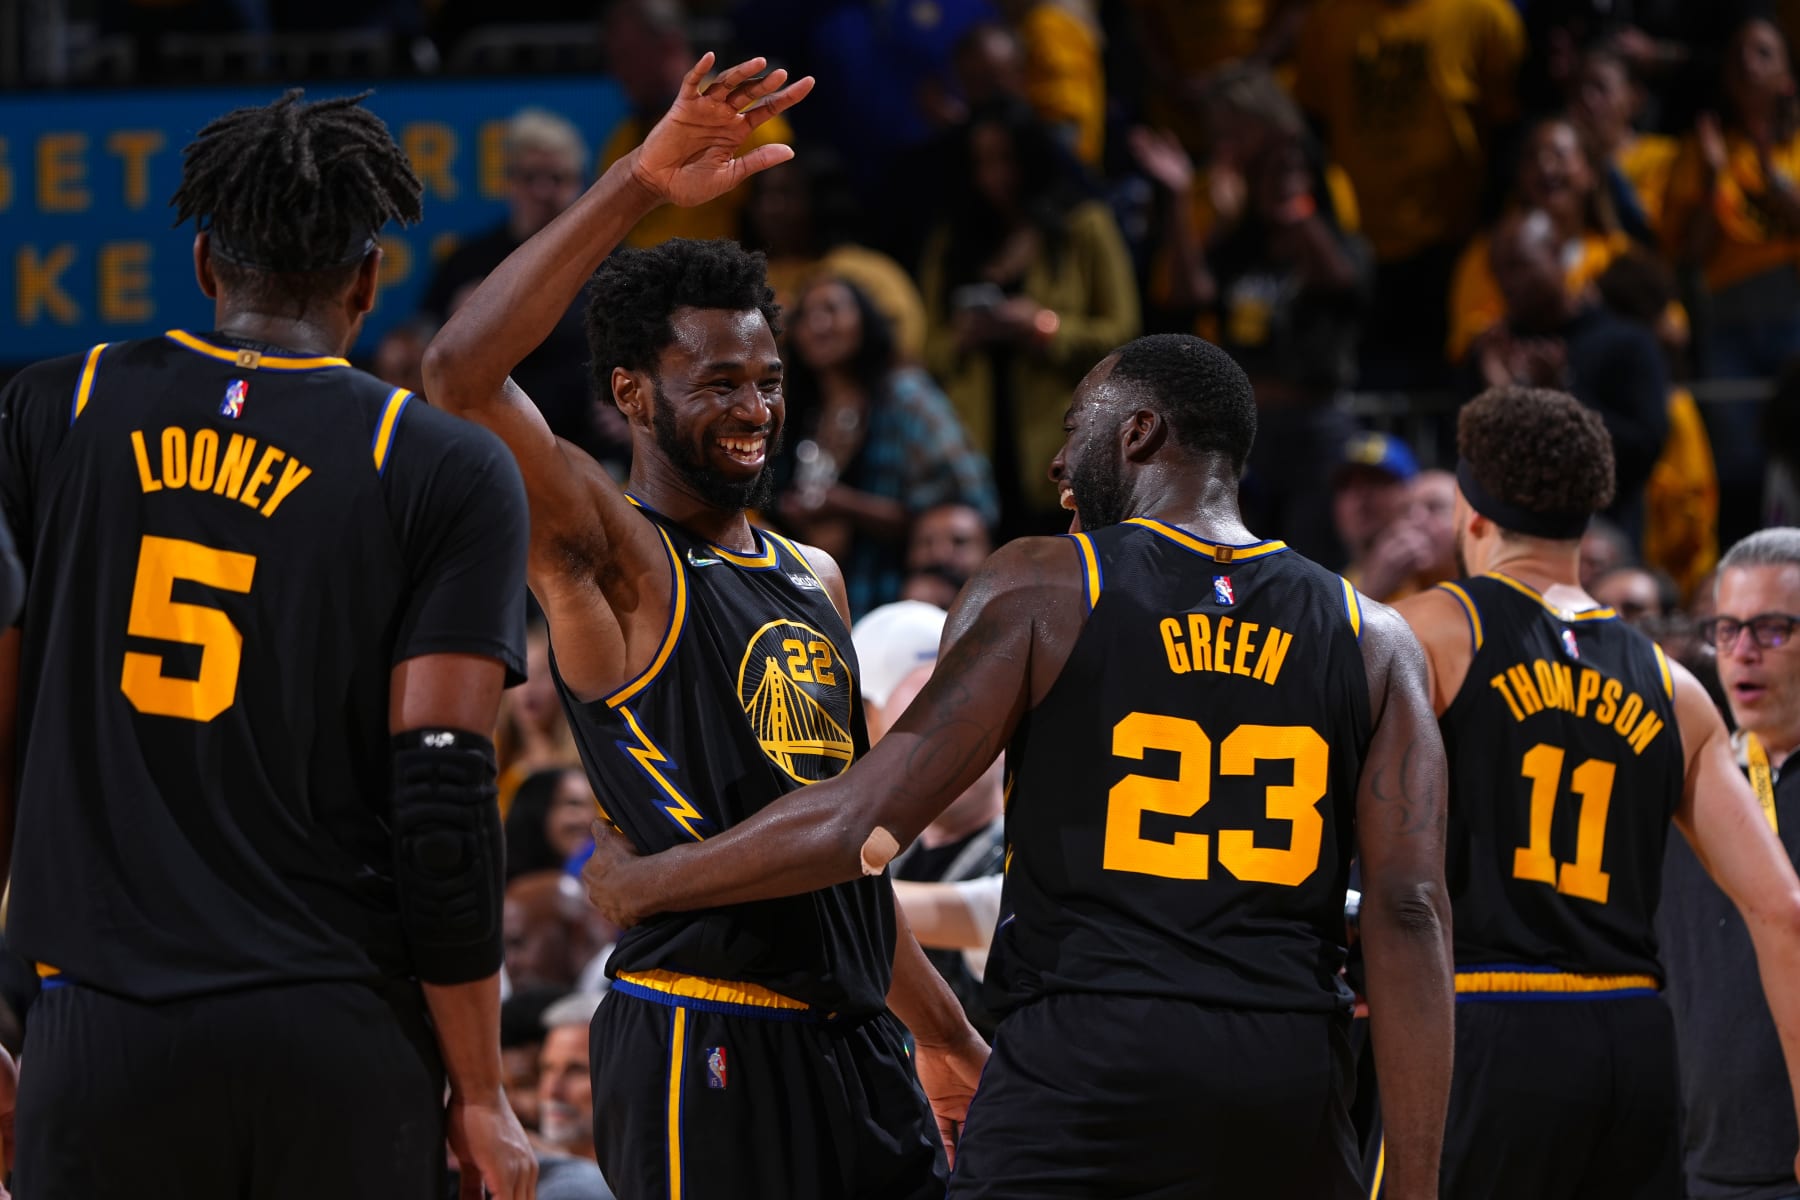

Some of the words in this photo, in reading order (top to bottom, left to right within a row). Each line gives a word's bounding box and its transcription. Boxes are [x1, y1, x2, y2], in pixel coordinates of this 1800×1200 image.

[0, 130, 165, 212] ET
[131, 427, 311, 517] LOONEY
[121, 536, 256, 722] 5
[782, 639, 836, 686] 22
[1160, 614, 1293, 685] GREEN
[1490, 658, 1664, 756] THOMPSON
[1103, 712, 1329, 886] 23
[1514, 744, 1616, 903] 11
